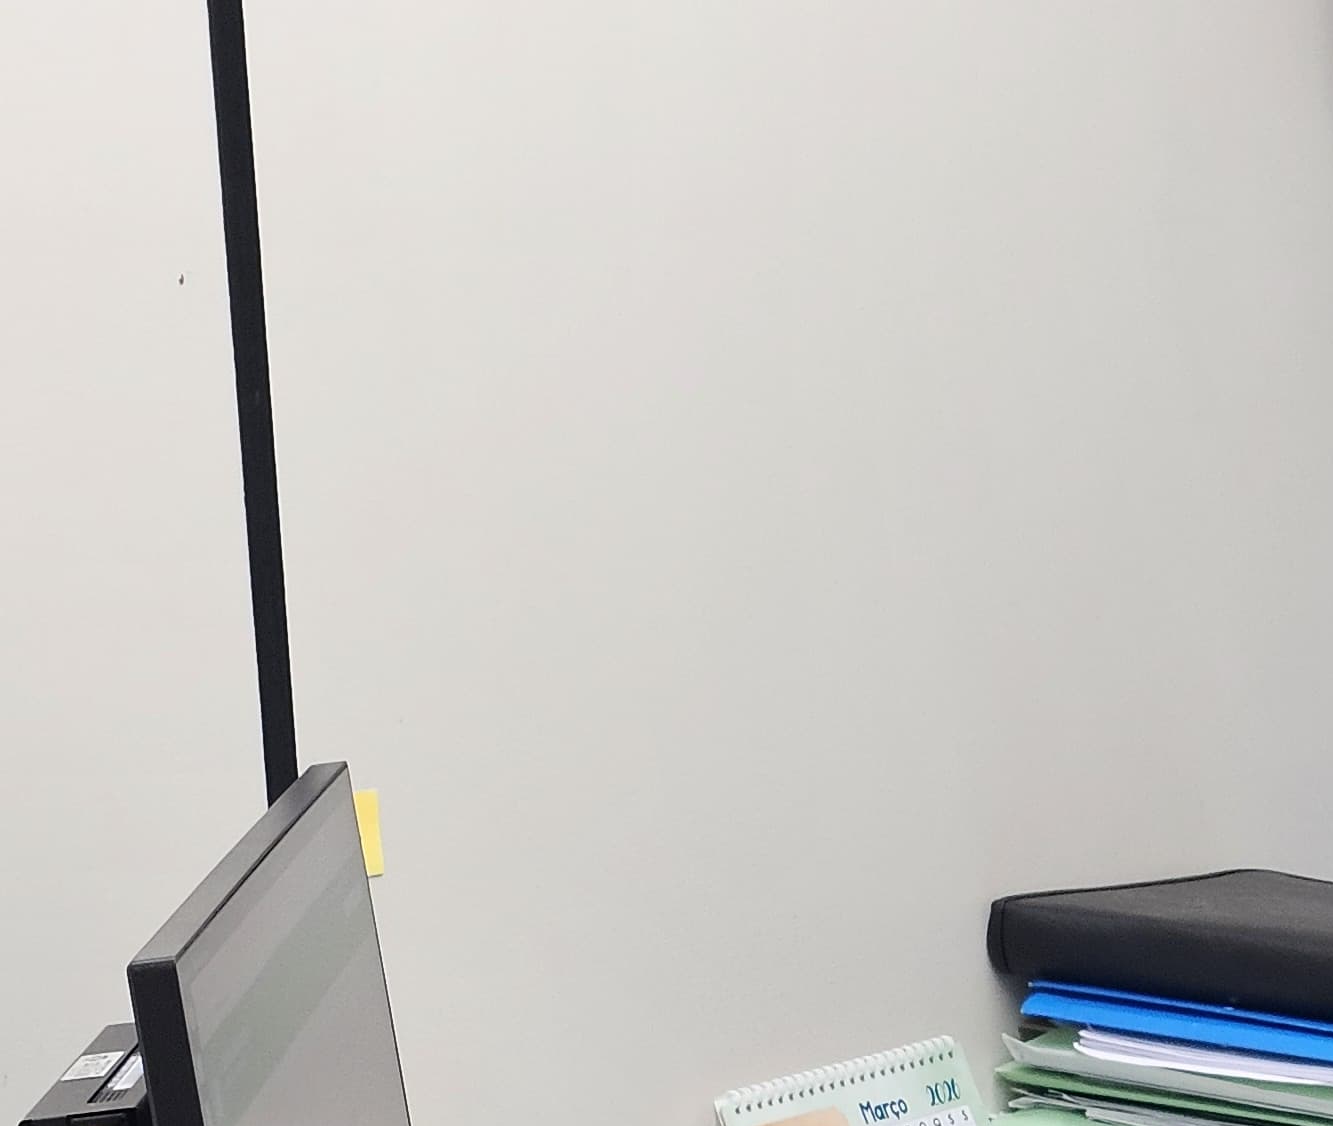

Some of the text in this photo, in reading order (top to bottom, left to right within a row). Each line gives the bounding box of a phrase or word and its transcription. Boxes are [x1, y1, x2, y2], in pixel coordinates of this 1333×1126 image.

[859, 1098, 909, 1124] Março
[947, 1113, 956, 1125] S
[961, 1109, 969, 1121] S
